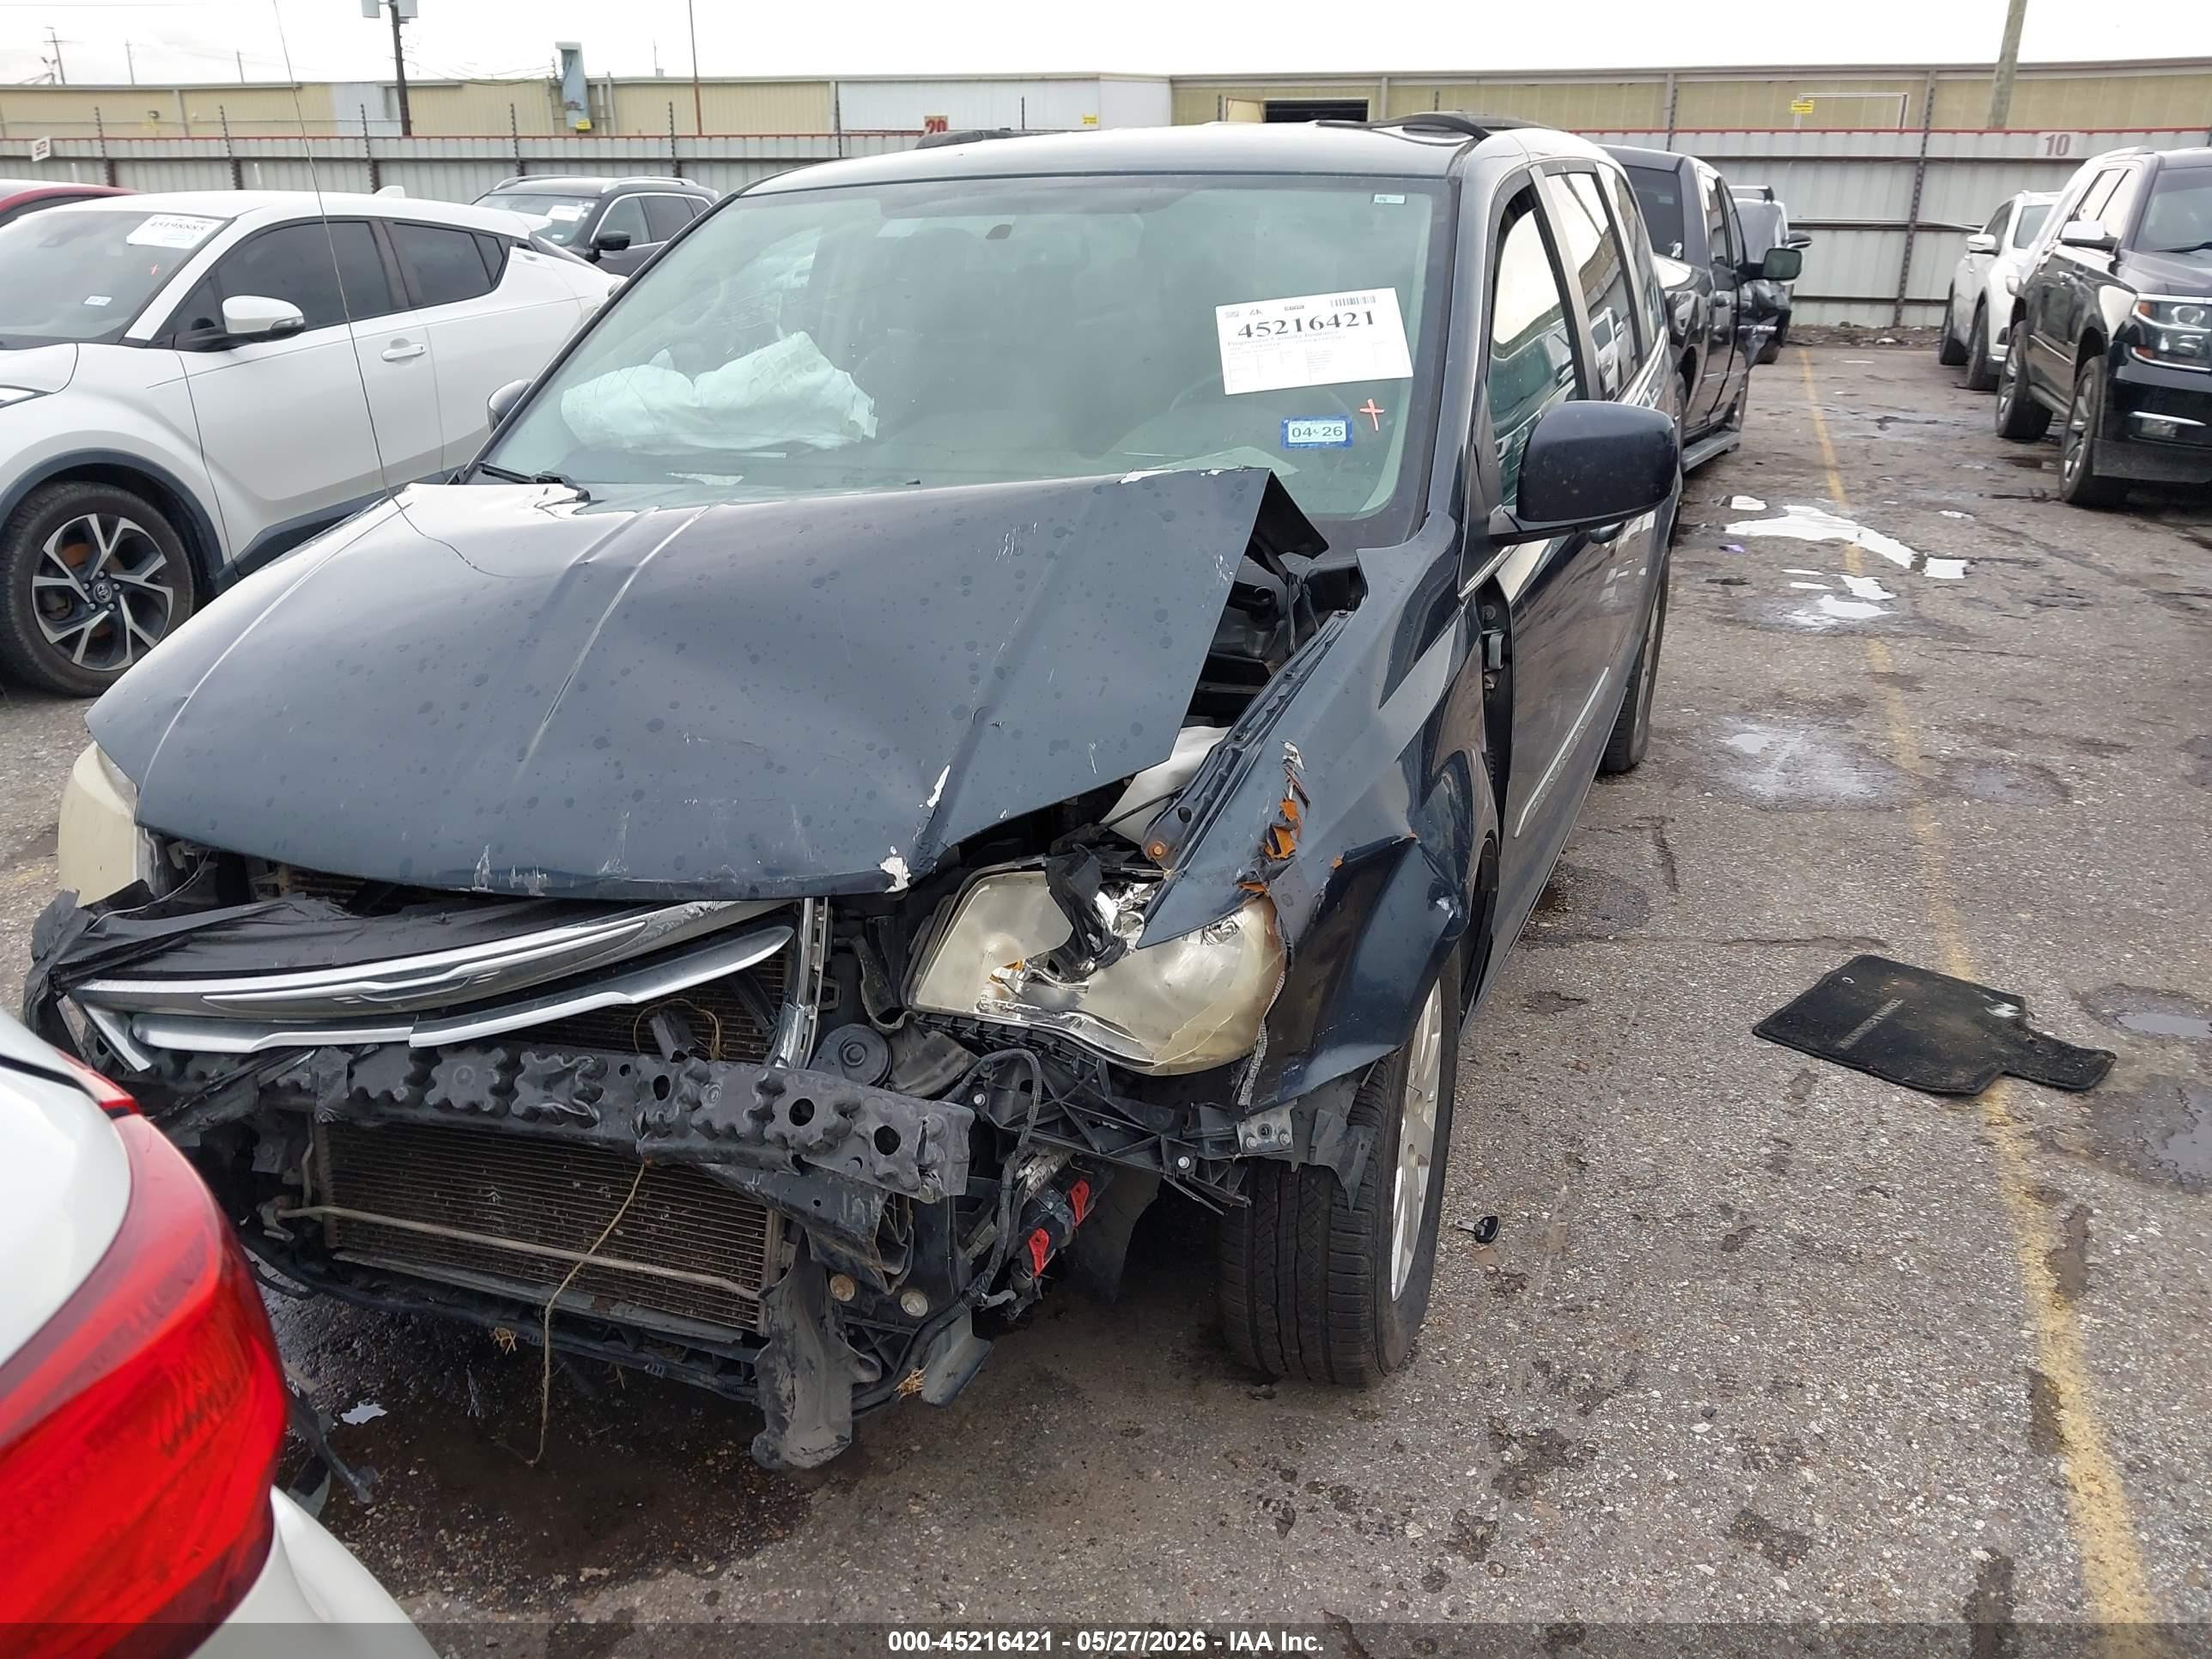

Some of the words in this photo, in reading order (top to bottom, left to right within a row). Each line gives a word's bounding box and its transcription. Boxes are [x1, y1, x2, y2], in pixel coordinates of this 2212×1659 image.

[925, 118, 947, 134] 20
[2045, 133, 2071, 156] 10
[1237, 309, 1374, 337] 45216421
[1291, 427, 1312, 438] 04
[1322, 426, 1343, 436] 26
